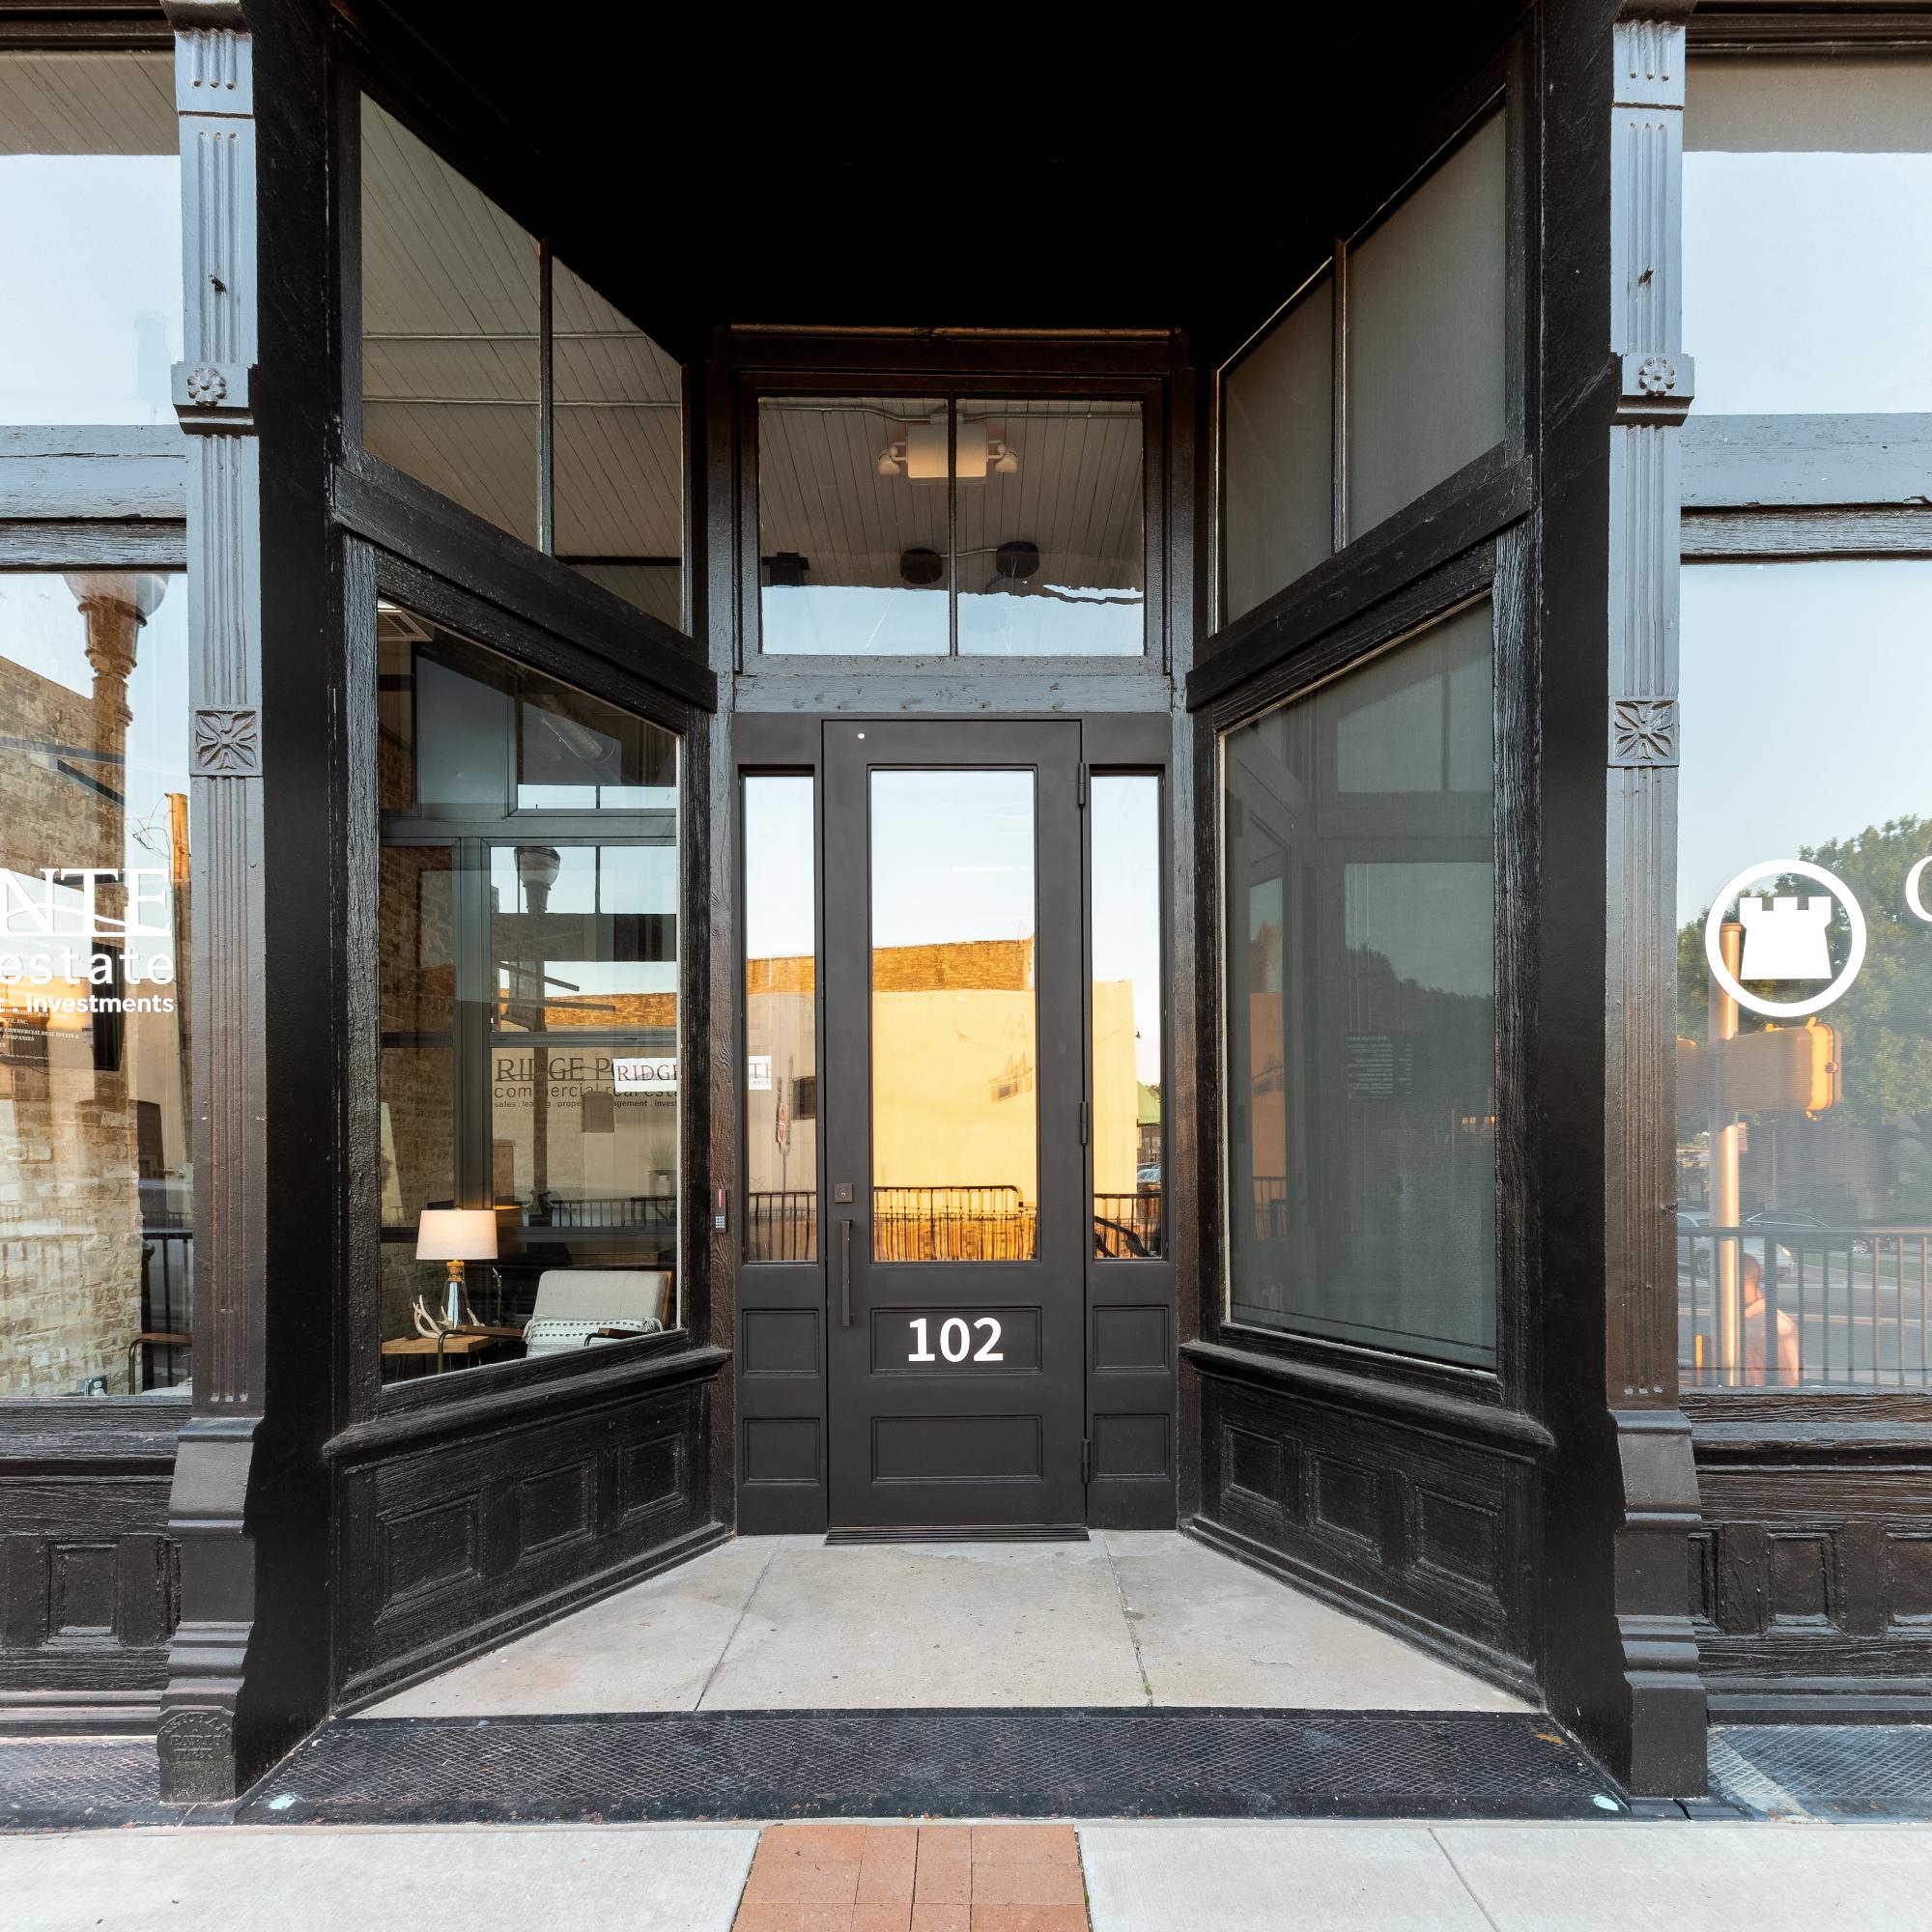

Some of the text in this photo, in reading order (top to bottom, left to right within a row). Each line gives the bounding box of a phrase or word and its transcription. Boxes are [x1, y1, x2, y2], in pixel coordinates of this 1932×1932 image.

[0, 948, 175, 984] estate
[26, 993, 175, 1012] investments
[909, 1318, 1004, 1362] 102
